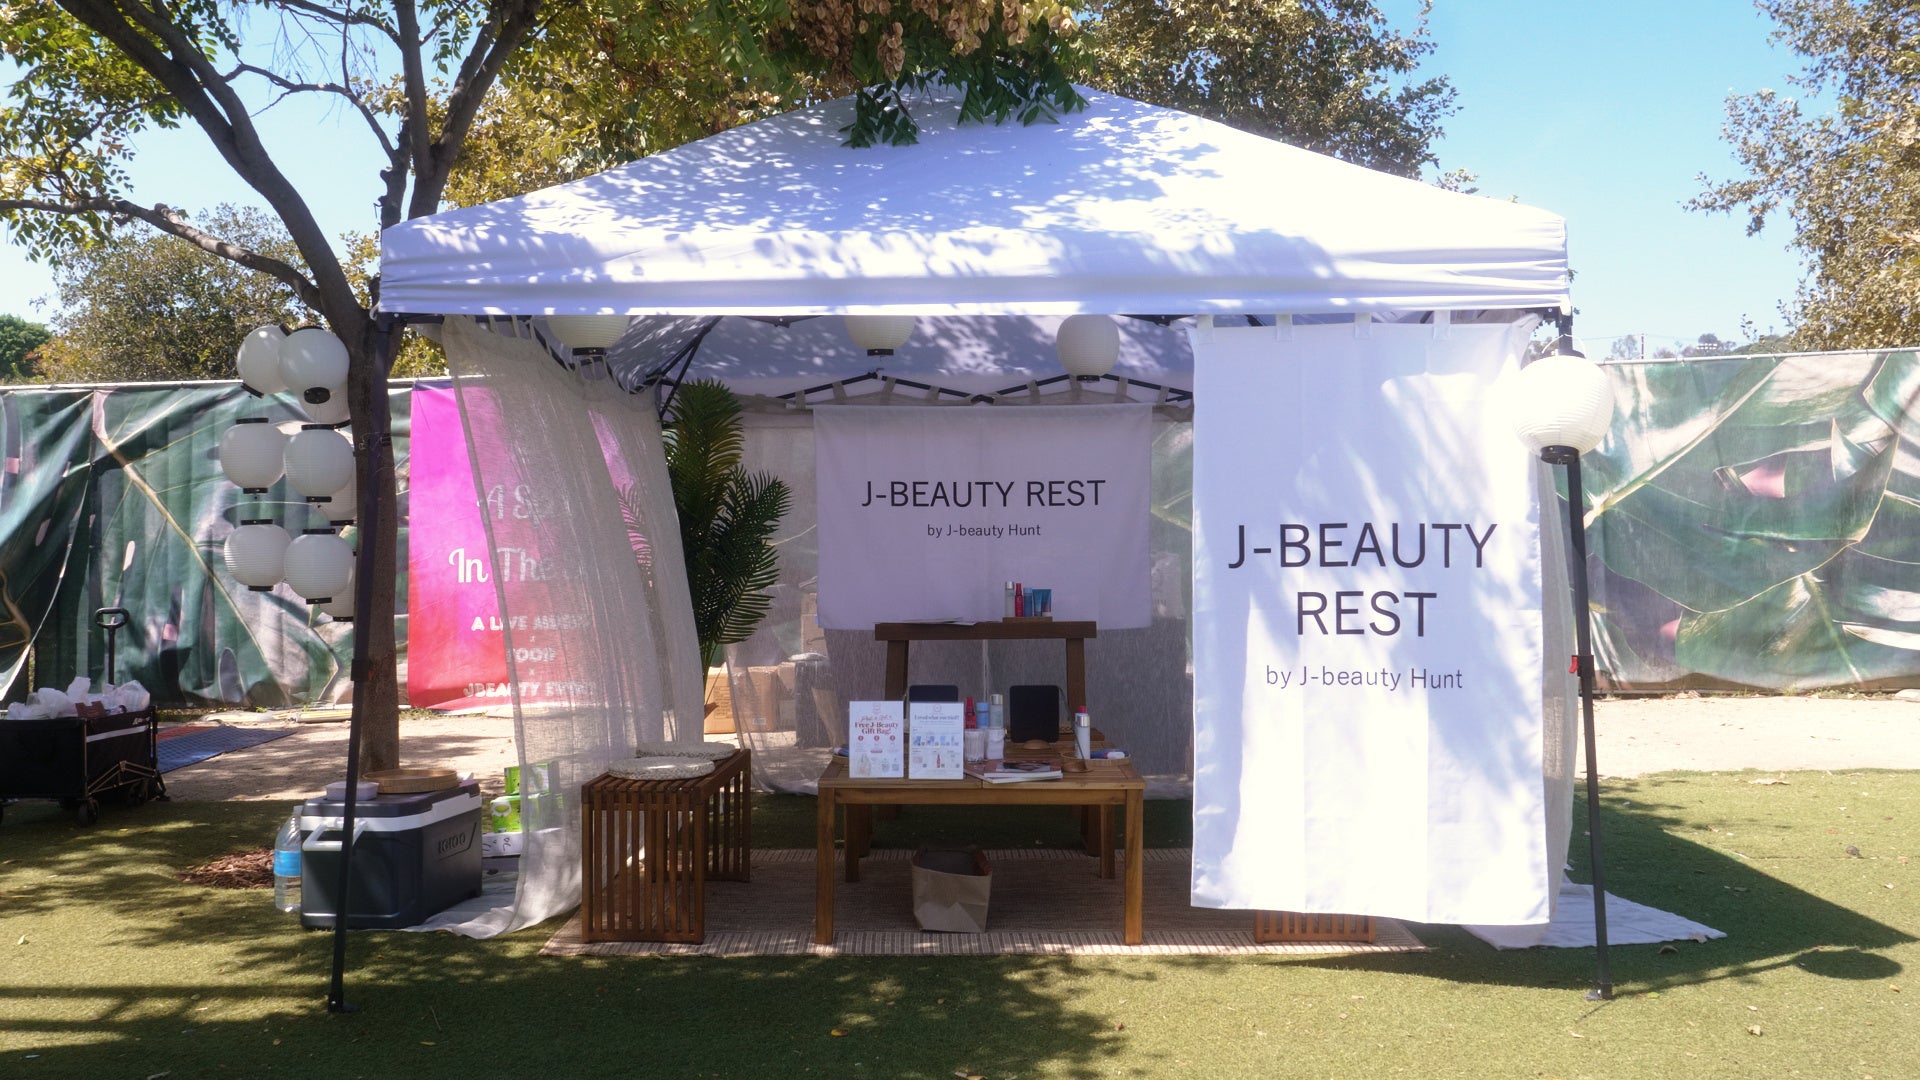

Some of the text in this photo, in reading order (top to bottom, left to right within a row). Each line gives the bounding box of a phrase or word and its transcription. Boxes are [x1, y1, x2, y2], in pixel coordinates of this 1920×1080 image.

[861, 479, 1106, 508] J-BEAUTY REST
[927, 523, 1041, 539] by J-beauty Hunt
[1228, 522, 1498, 569] J-BEAUTY
[448, 547, 489, 583] In
[471, 616, 485, 631] A
[1297, 590, 1437, 637] REST
[1266, 664, 1463, 692] by J-beauty Hunt
[854, 721, 869, 729] Free
